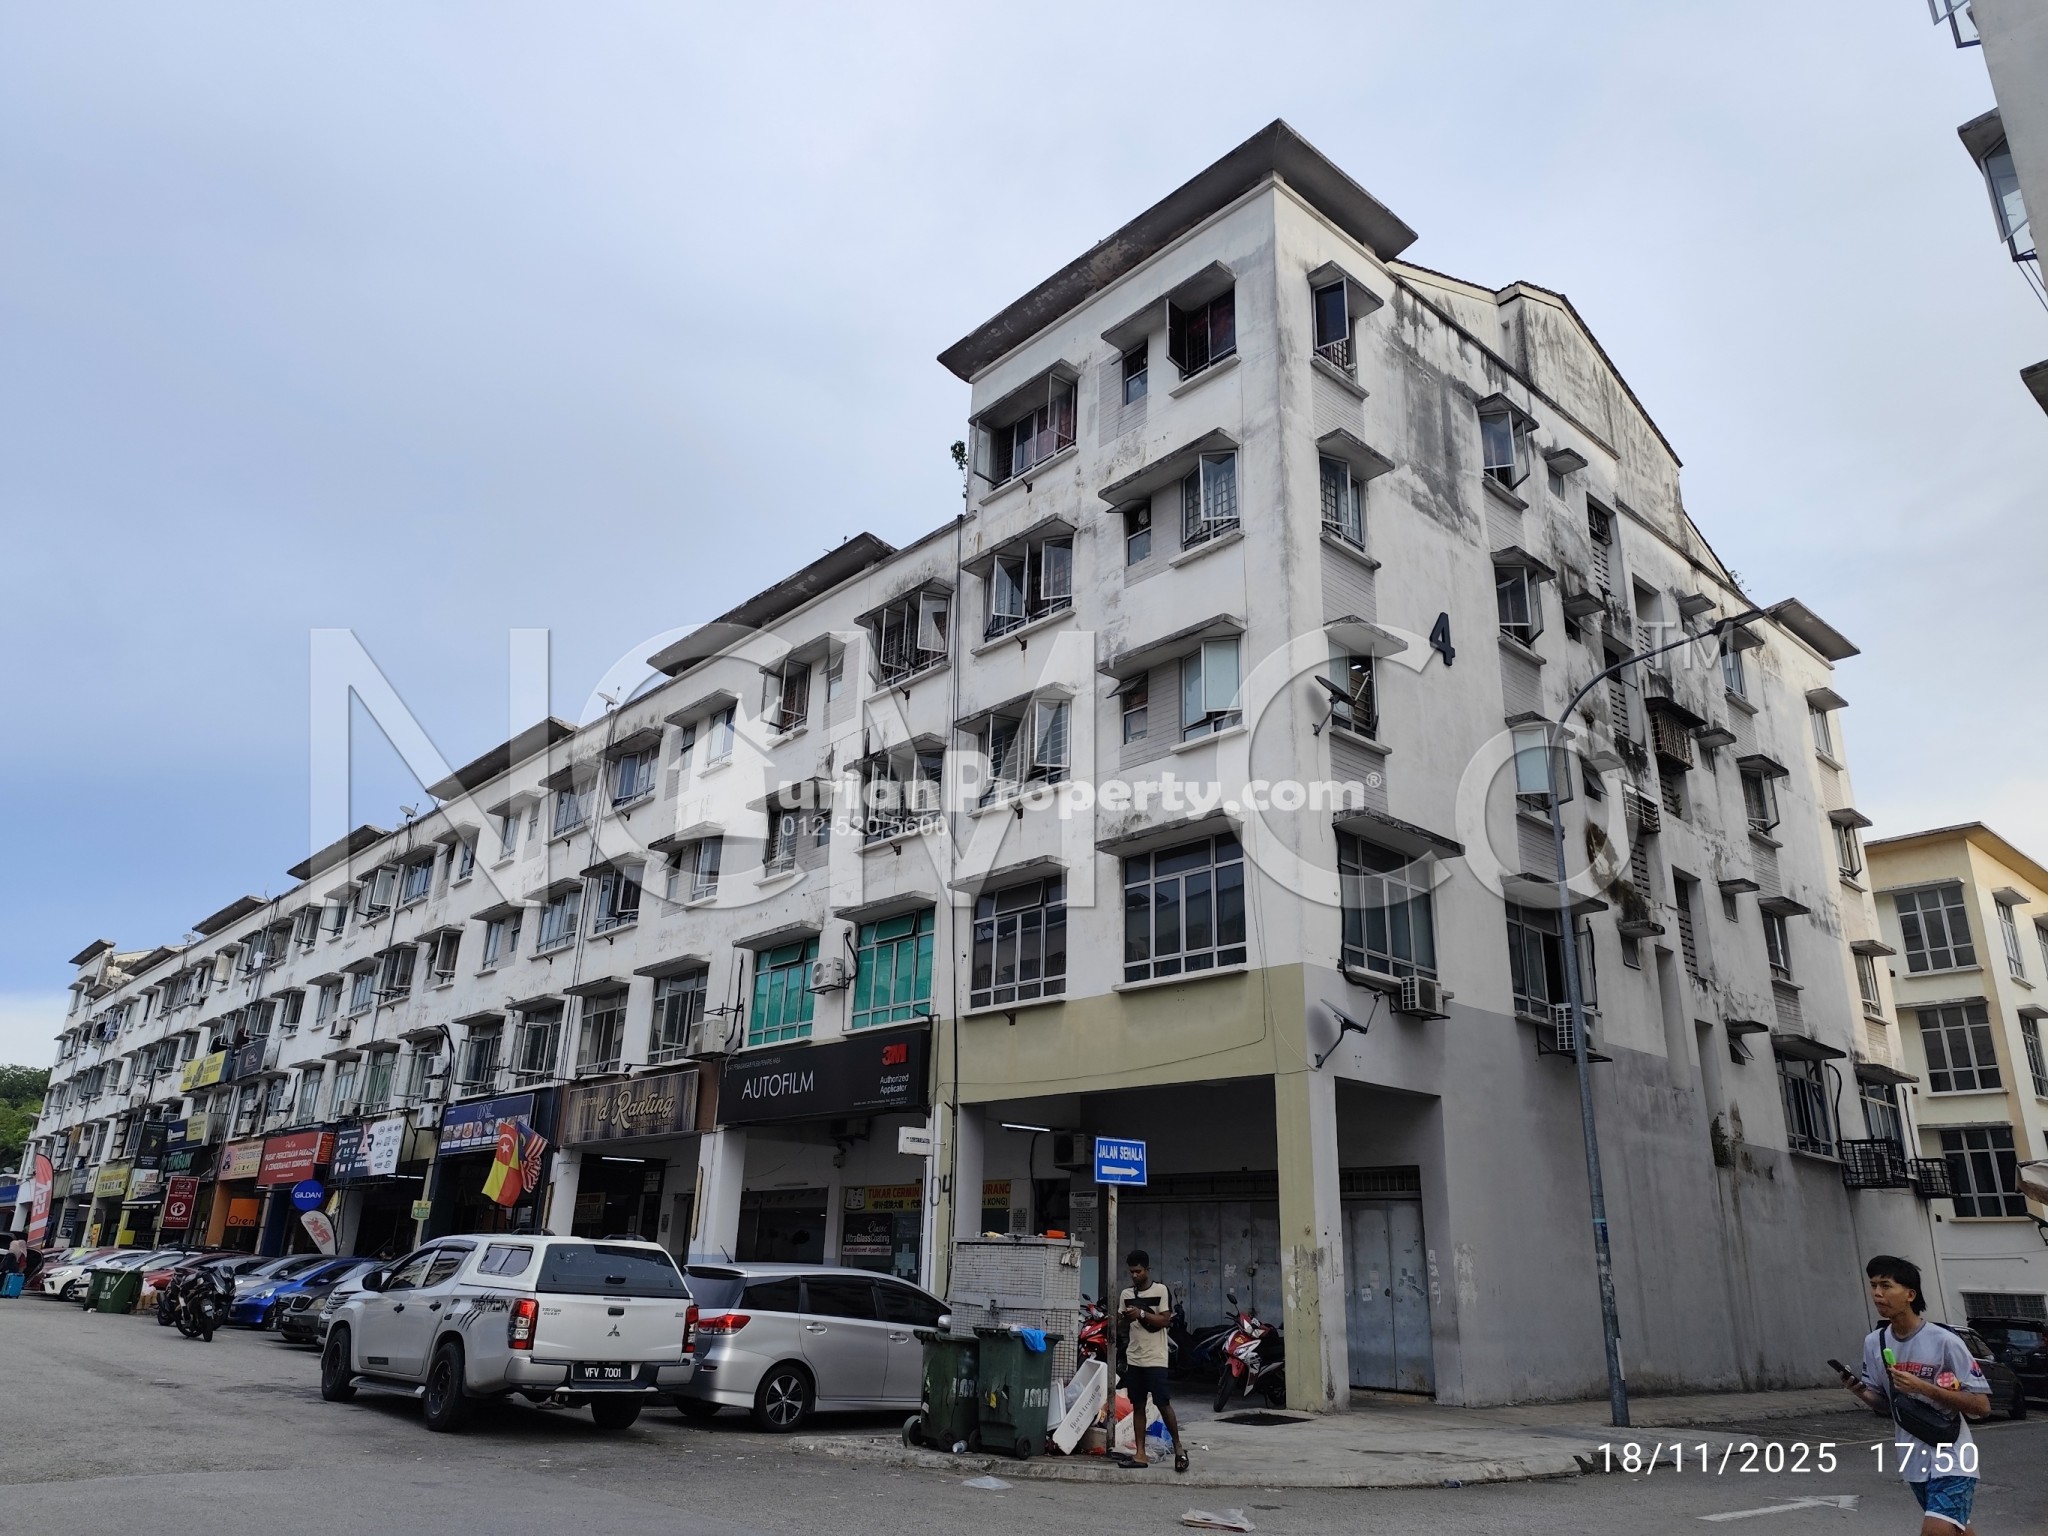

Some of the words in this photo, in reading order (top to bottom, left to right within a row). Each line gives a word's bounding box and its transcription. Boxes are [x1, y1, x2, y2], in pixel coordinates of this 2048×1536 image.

[1430, 613, 1456, 667] 4
[881, 1043, 908, 1066] 3M
[880, 1073, 909, 1085] Authorized
[742, 1070, 814, 1100] AUTOFILM
[880, 1084, 907, 1095] Applicator
[1098, 1144, 1118, 1159] JALAN
[1119, 1146, 1143, 1161] SEHALA
[294, 1191, 321, 1199] GILDAN
[868, 1188, 891, 1198] TUKAR
[893, 1187, 919, 1197] CERMIN
[228, 1216, 254, 1226] Oren
[585, 1367, 599, 1378] VFV
[604, 1367, 621, 1378] 7001
